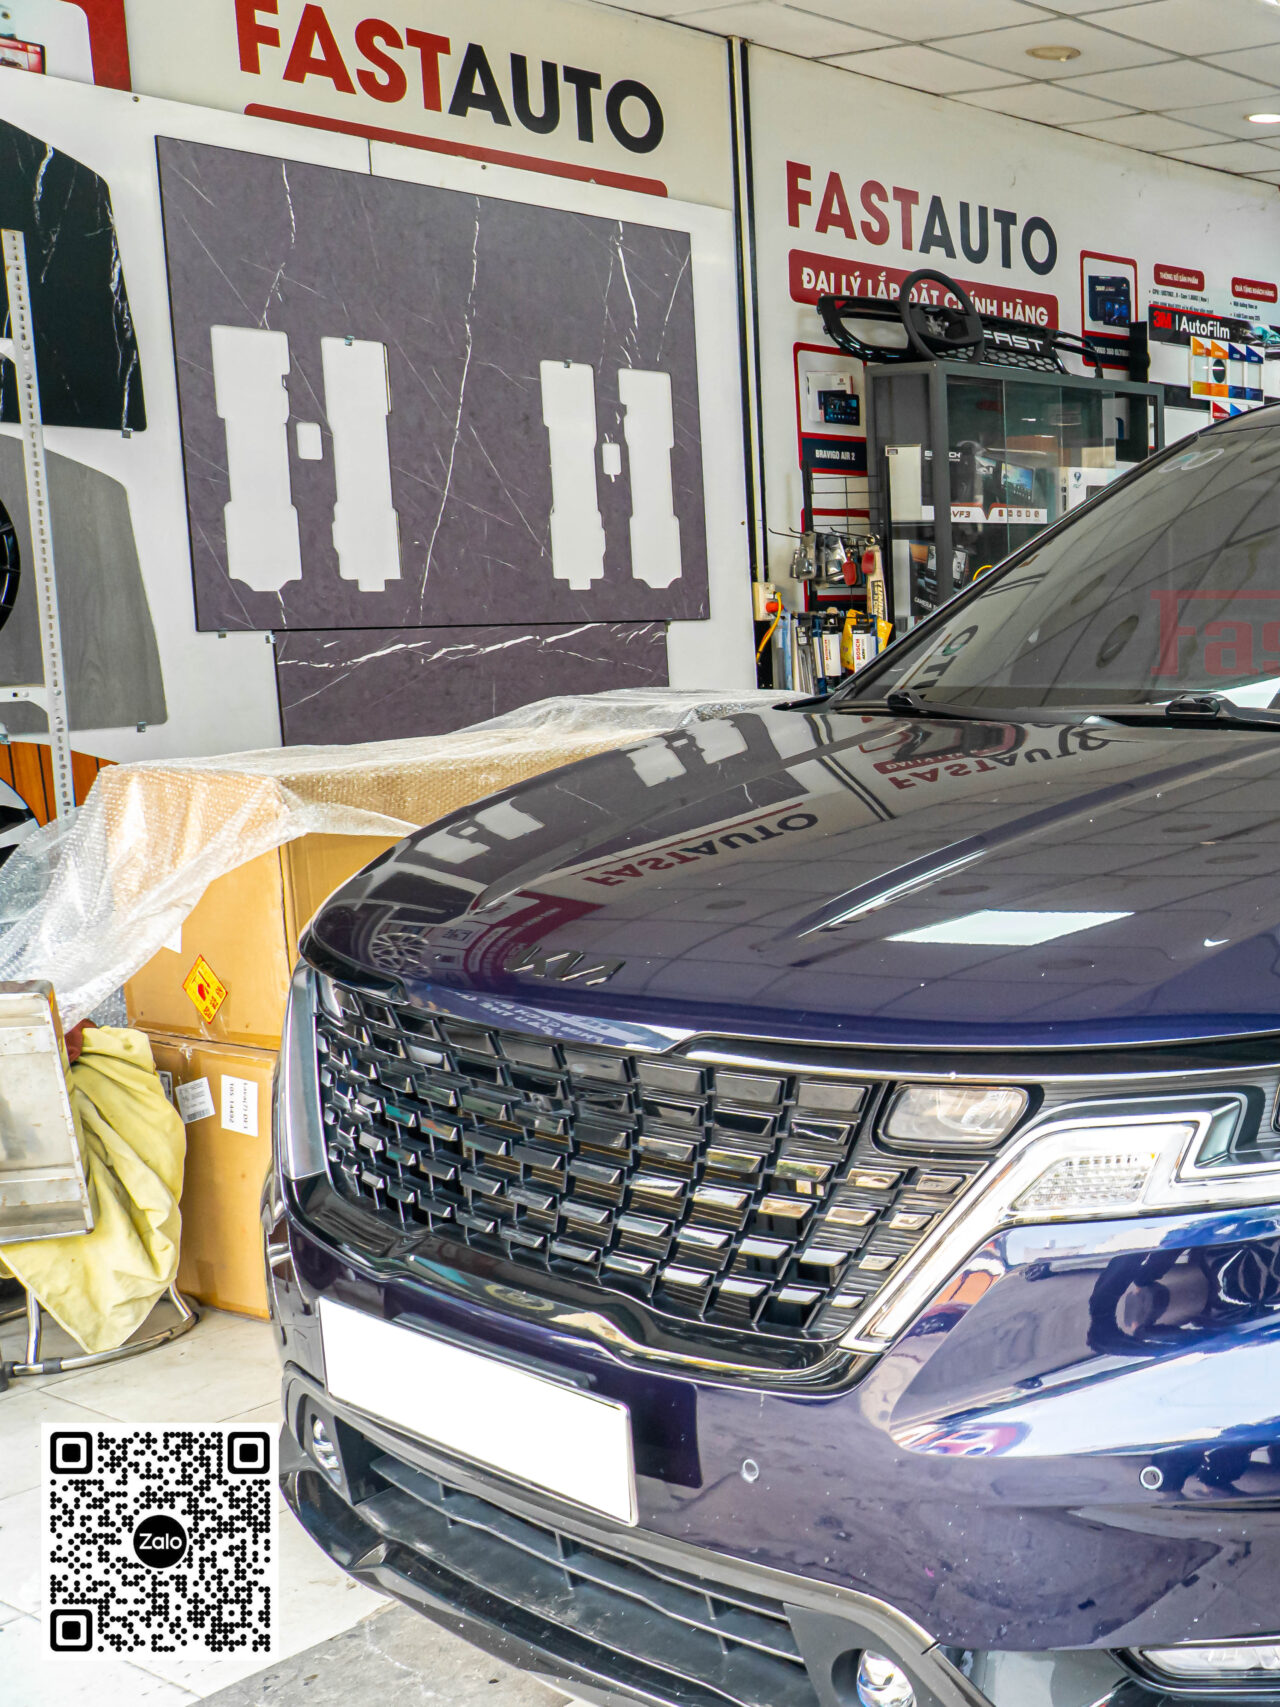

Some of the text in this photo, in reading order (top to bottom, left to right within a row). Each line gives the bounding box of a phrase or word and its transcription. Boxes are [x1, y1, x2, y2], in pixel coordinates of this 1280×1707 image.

[234, 0, 664, 154] FASTAUTO
[786, 160, 1057, 276] FASTAUTO
[841, 271, 861, 296] LÝ
[1002, 293, 1049, 326] HÃNG
[1152, 310, 1173, 330] 3M
[1179, 316, 1231, 340] AutoFilm
[983, 329, 1044, 352] FAST
[815, 449, 856, 461] BRAVIGO AIR 2
[952, 510, 971, 519] VF3
